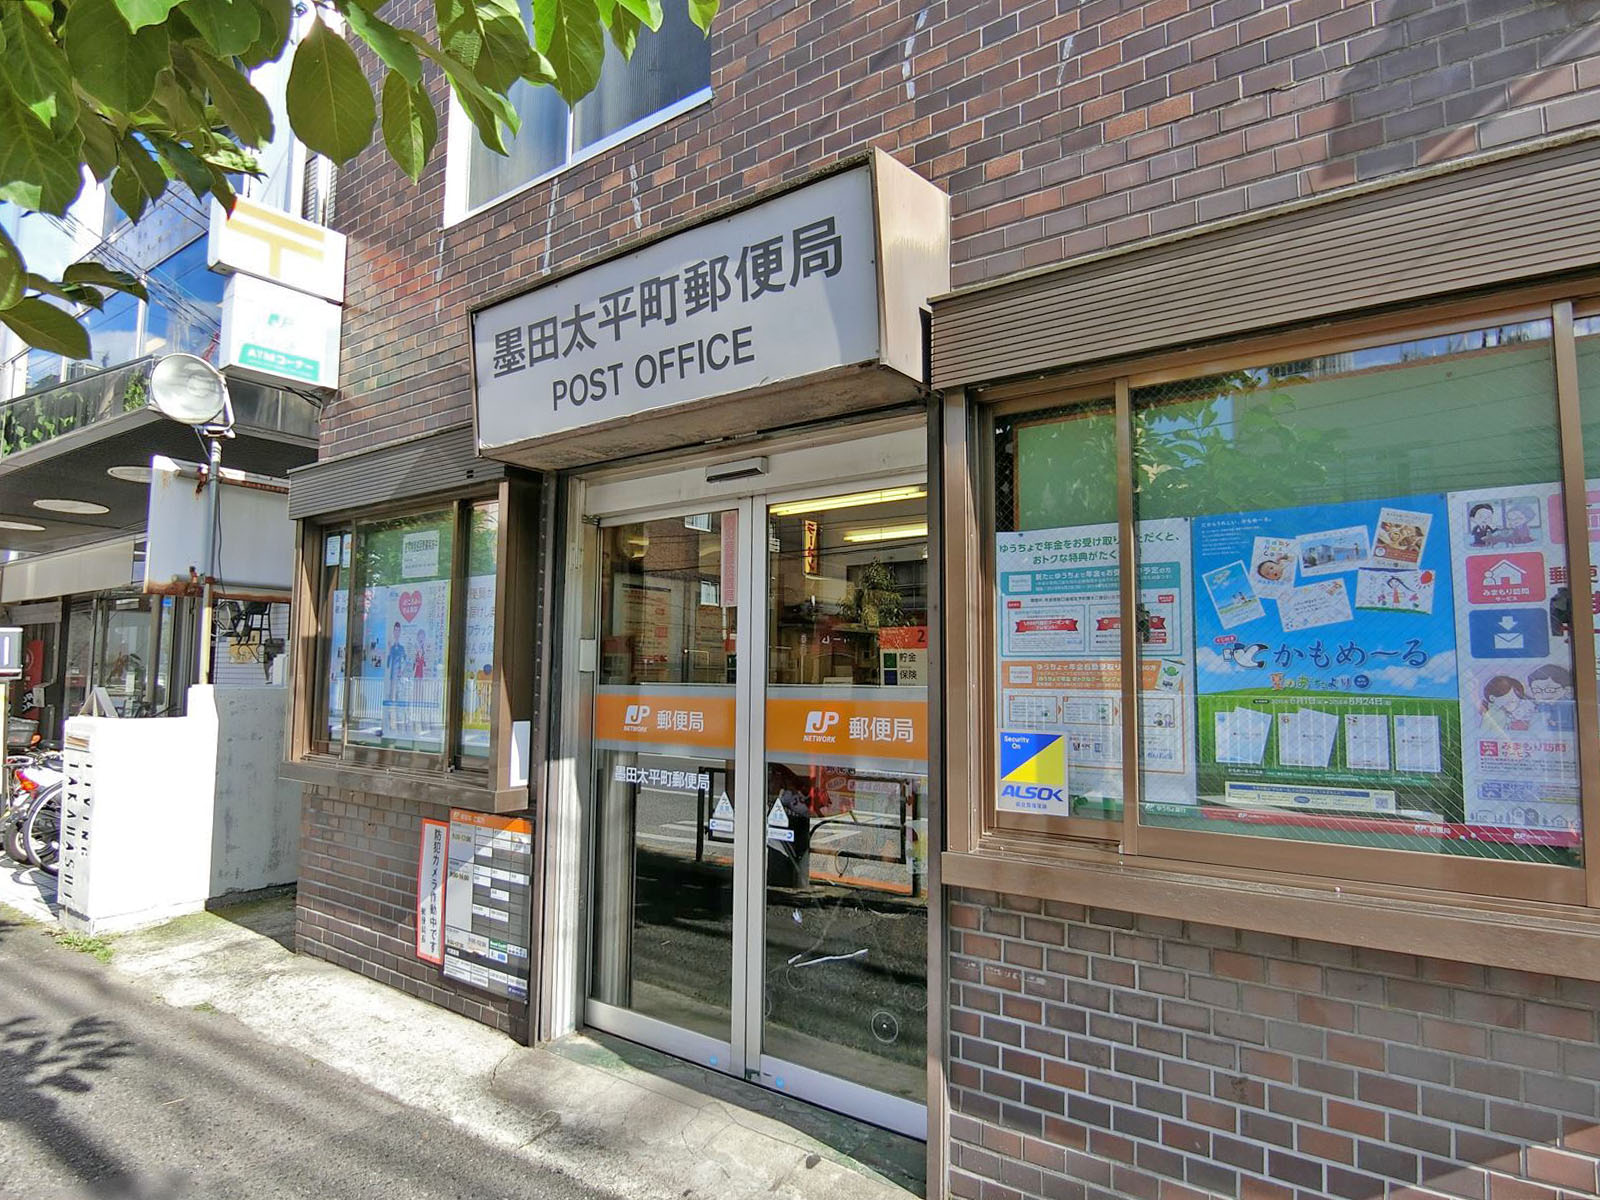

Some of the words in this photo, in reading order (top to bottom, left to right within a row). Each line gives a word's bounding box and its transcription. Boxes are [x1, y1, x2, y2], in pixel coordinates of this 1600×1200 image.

[493, 216, 842, 378] 墨田太平町郵便局
[552, 362, 623, 411] POST
[634, 325, 755, 389] OFFICE
[999, 532, 1180, 553] ゆうちょで年金をお受け取りだくと、
[917, 630, 925, 643] 2
[900, 652, 917, 663] 貯金
[900, 669, 917, 680] 保険
[625, 705, 650, 725] JP
[657, 710, 704, 732] 郵便局
[805, 710, 840, 734] JP
[623, 724, 648, 732] NETWORK
[848, 717, 914, 743] 郵便局
[803, 734, 836, 743] NETWORK
[1004, 735, 1030, 745] Security
[1011, 742, 1022, 750] On
[614, 764, 710, 792] 墨田太平町郵便局
[1001, 784, 1064, 802] ALSOK
